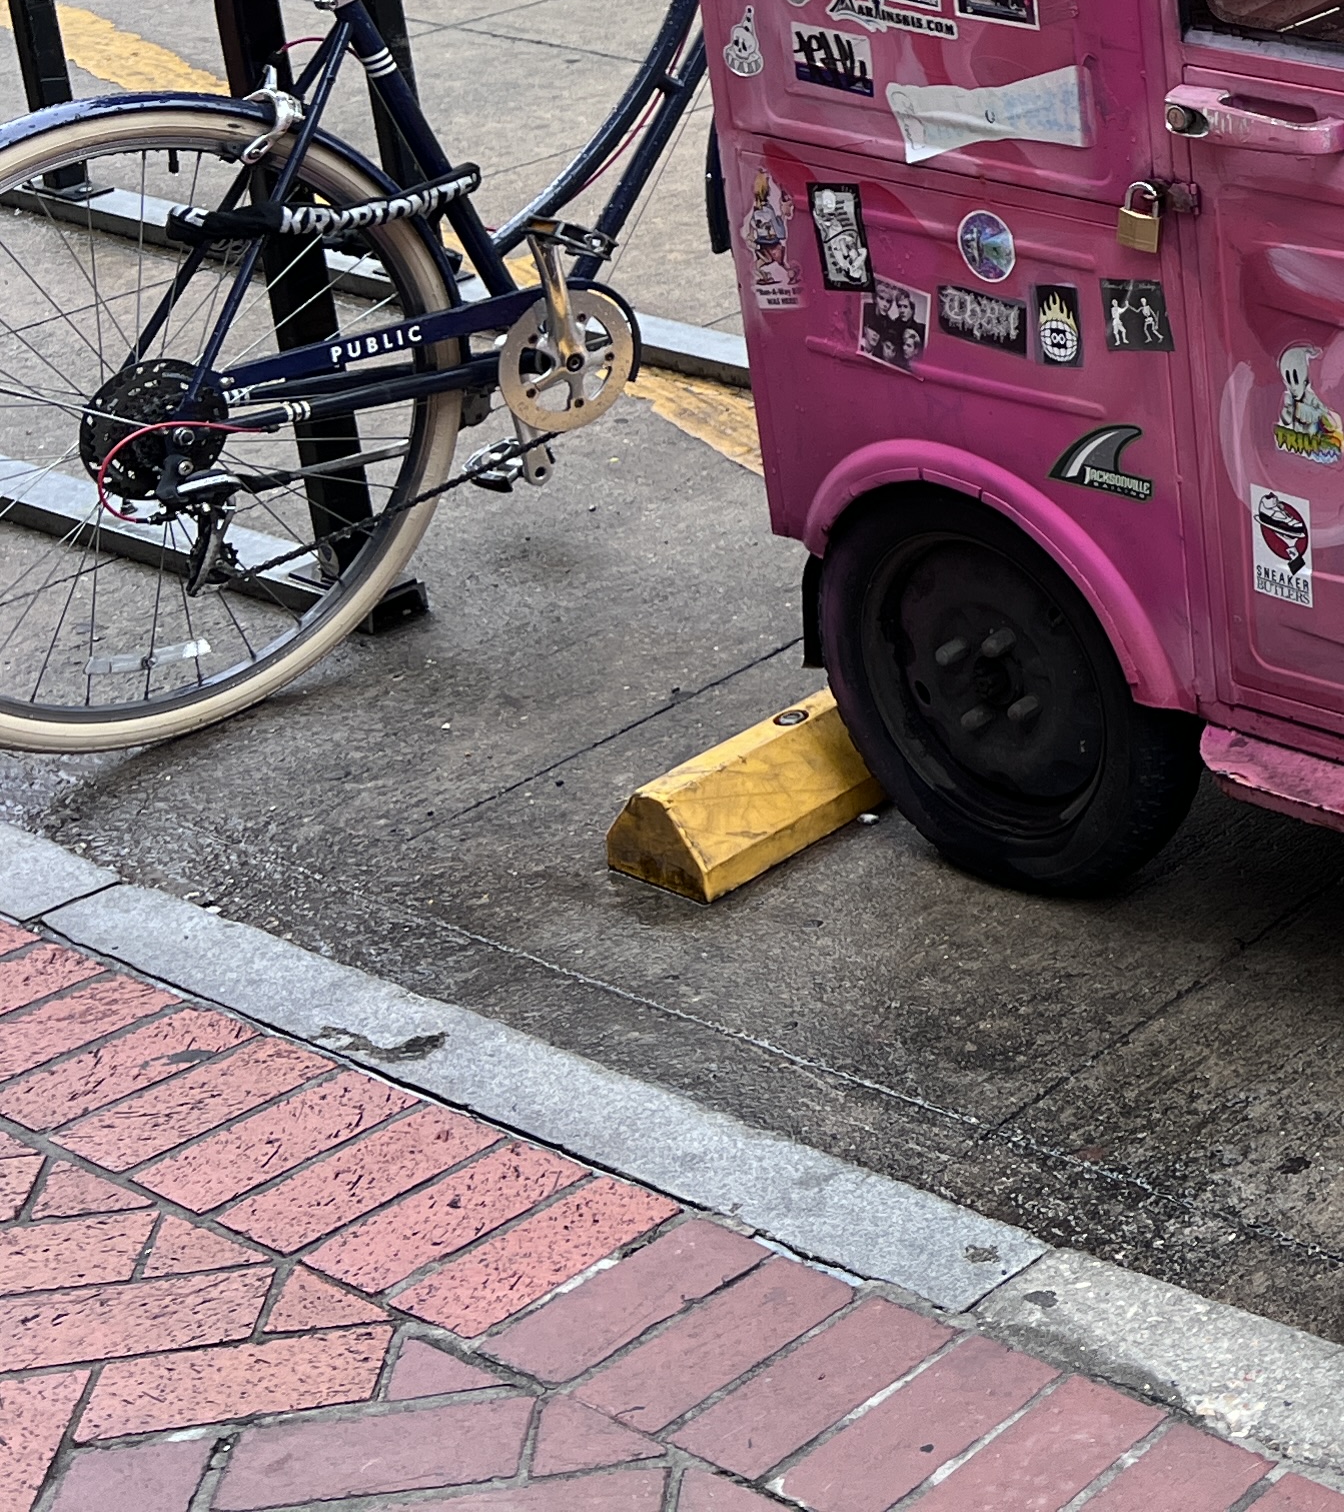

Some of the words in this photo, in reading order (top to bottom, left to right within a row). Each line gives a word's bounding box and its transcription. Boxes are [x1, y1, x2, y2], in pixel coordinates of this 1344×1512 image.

[330, 325, 423, 364] PUBLIC
[1084, 466, 1150, 494] JACKSONVILLE
[1256, 565, 1310, 591] SNEAKER
[1256, 576, 1311, 605] BUTLERS
